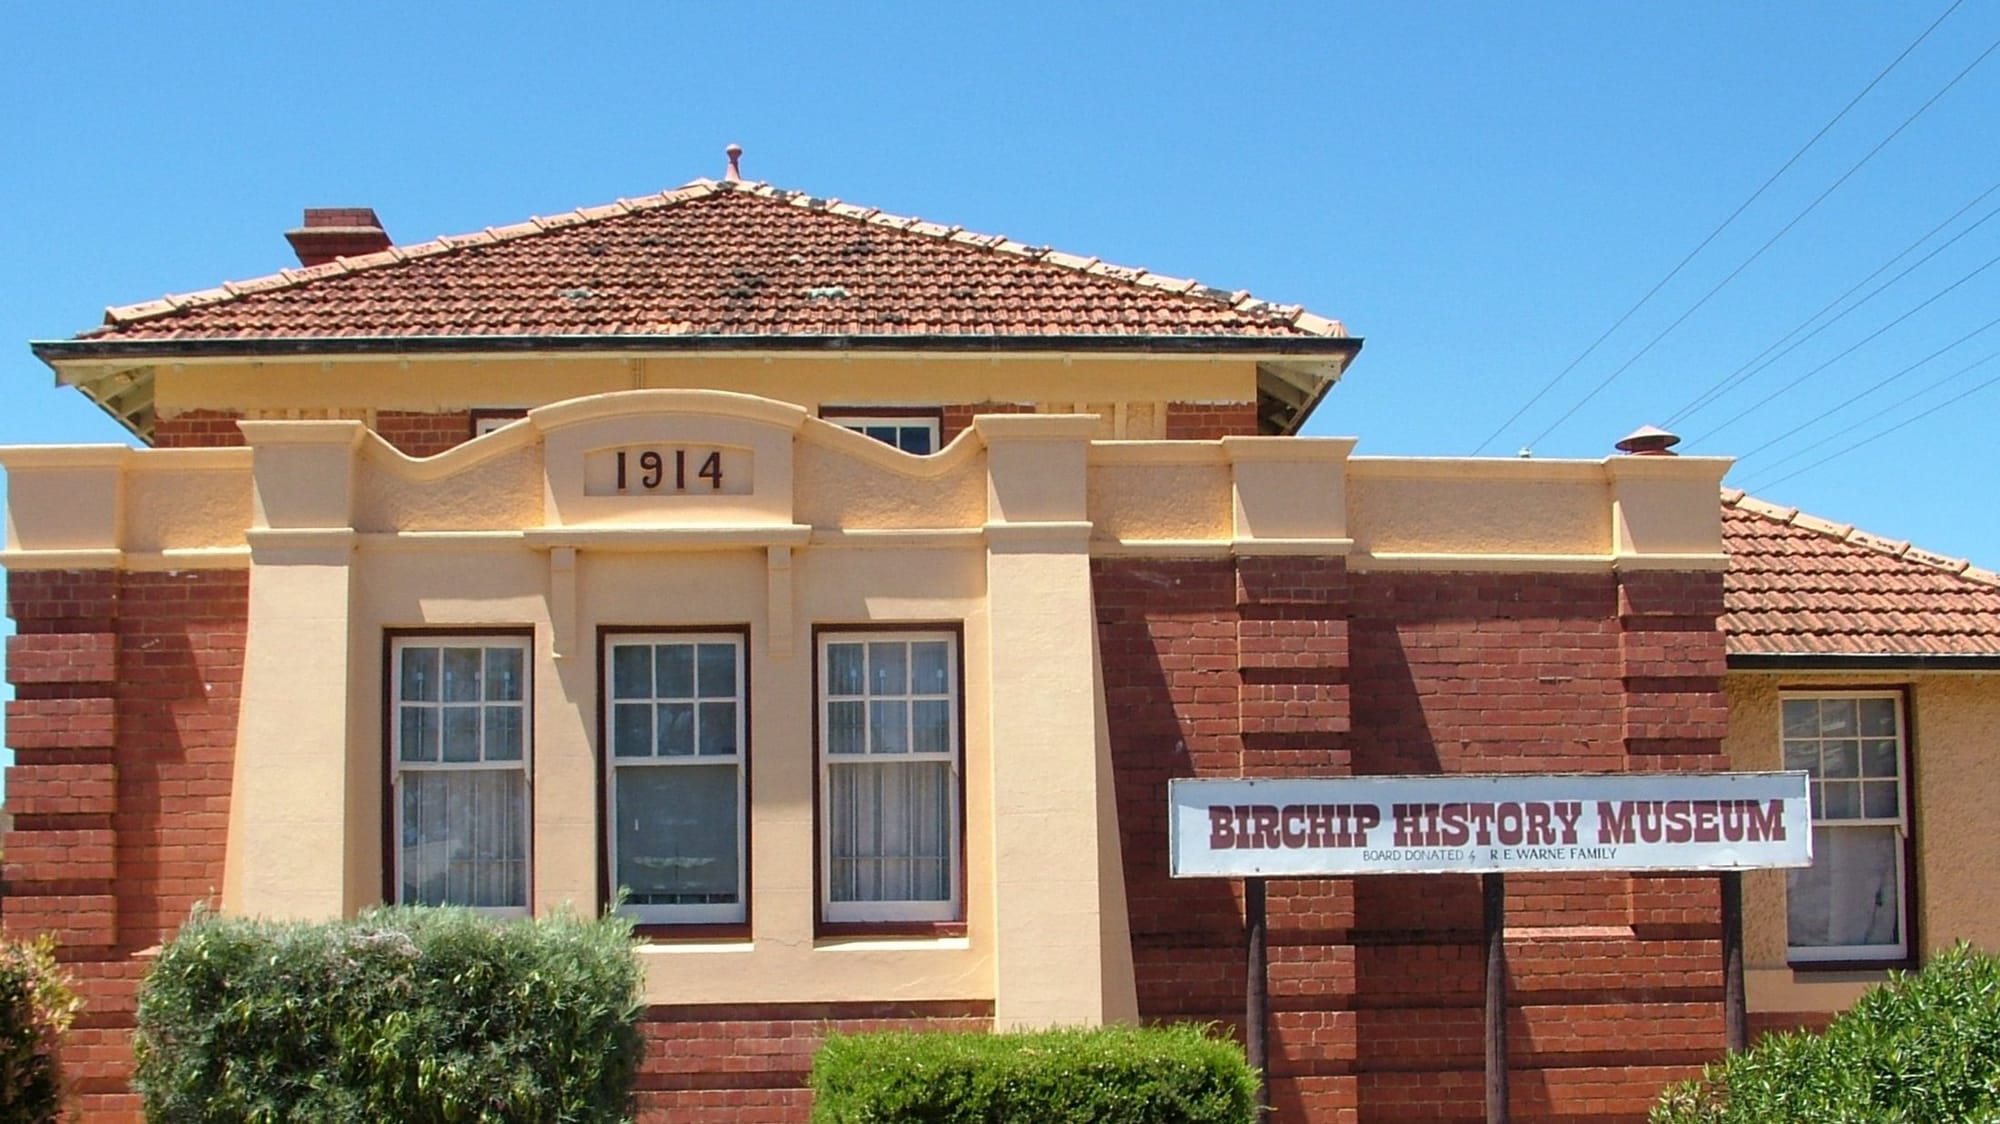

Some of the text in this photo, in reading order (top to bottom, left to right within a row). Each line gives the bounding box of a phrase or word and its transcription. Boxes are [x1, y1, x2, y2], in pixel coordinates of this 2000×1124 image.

[616, 450, 723, 489] 1914
[1208, 799, 1786, 849] BIRCHIP HISTORY MUSEUM
[1363, 850, 1400, 861] BOARD
[1405, 850, 1463, 861] DONATED
[1516, 848, 1565, 860] WARNE
[1570, 847, 1617, 859] FAMILY
